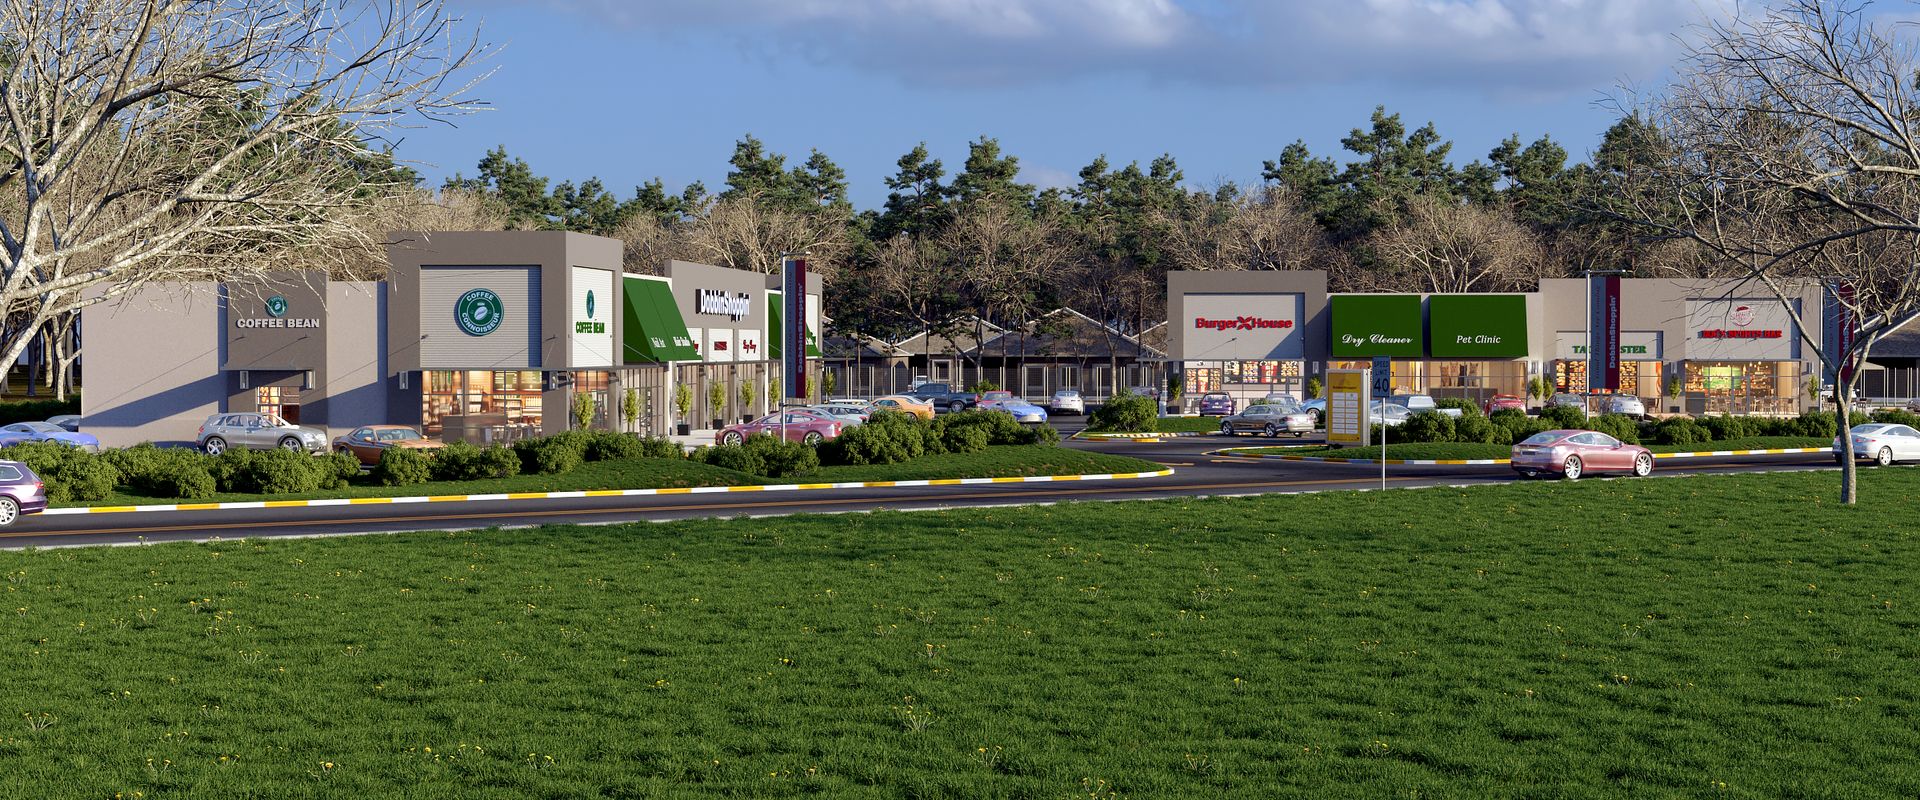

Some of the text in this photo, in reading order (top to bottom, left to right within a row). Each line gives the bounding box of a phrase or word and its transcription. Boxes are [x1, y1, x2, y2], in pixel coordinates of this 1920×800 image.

[466, 291, 494, 301] COFFEE
[237, 318, 320, 328] COFFEE BEAN
[462, 312, 500, 332] CONNOISSEUR
[576, 321, 593, 334] COFFEE
[1341, 333, 1413, 347] Dry Cleaner
[1456, 334, 1501, 344] Pet Clinic
[1374, 378, 1390, 392] 40
